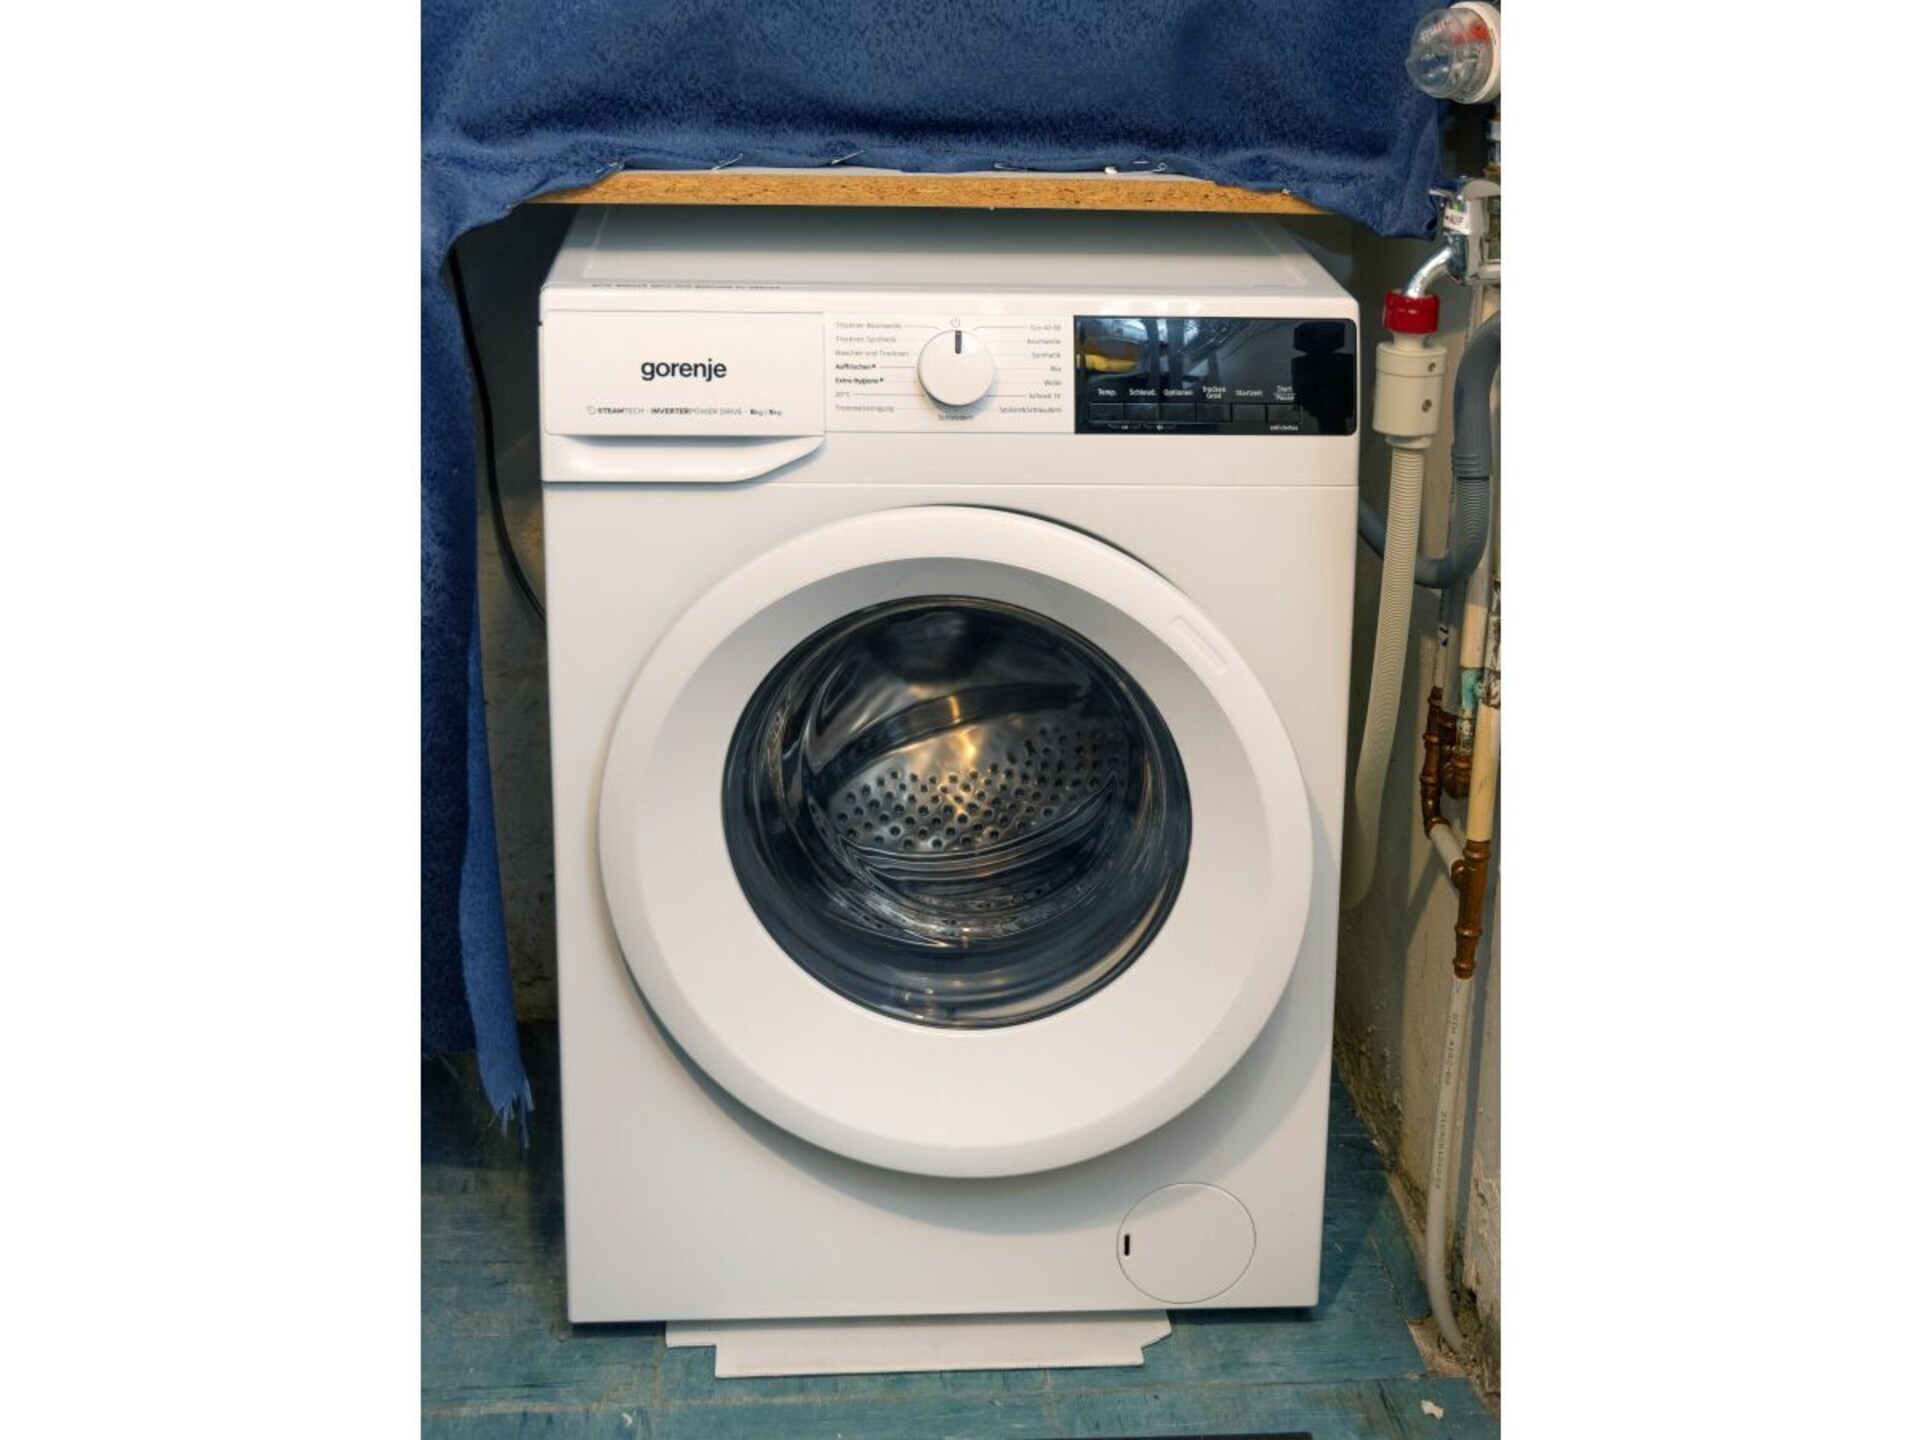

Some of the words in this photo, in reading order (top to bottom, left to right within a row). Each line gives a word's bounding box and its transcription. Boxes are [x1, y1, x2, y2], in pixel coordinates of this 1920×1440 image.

[641, 358, 728, 382] gorenje
[1097, 388, 1117, 397] Temp.
[1129, 388, 1157, 397] Schleud.
[1162, 388, 1194, 397] Optionen
[597, 407, 644, 415] STEAMTECH
